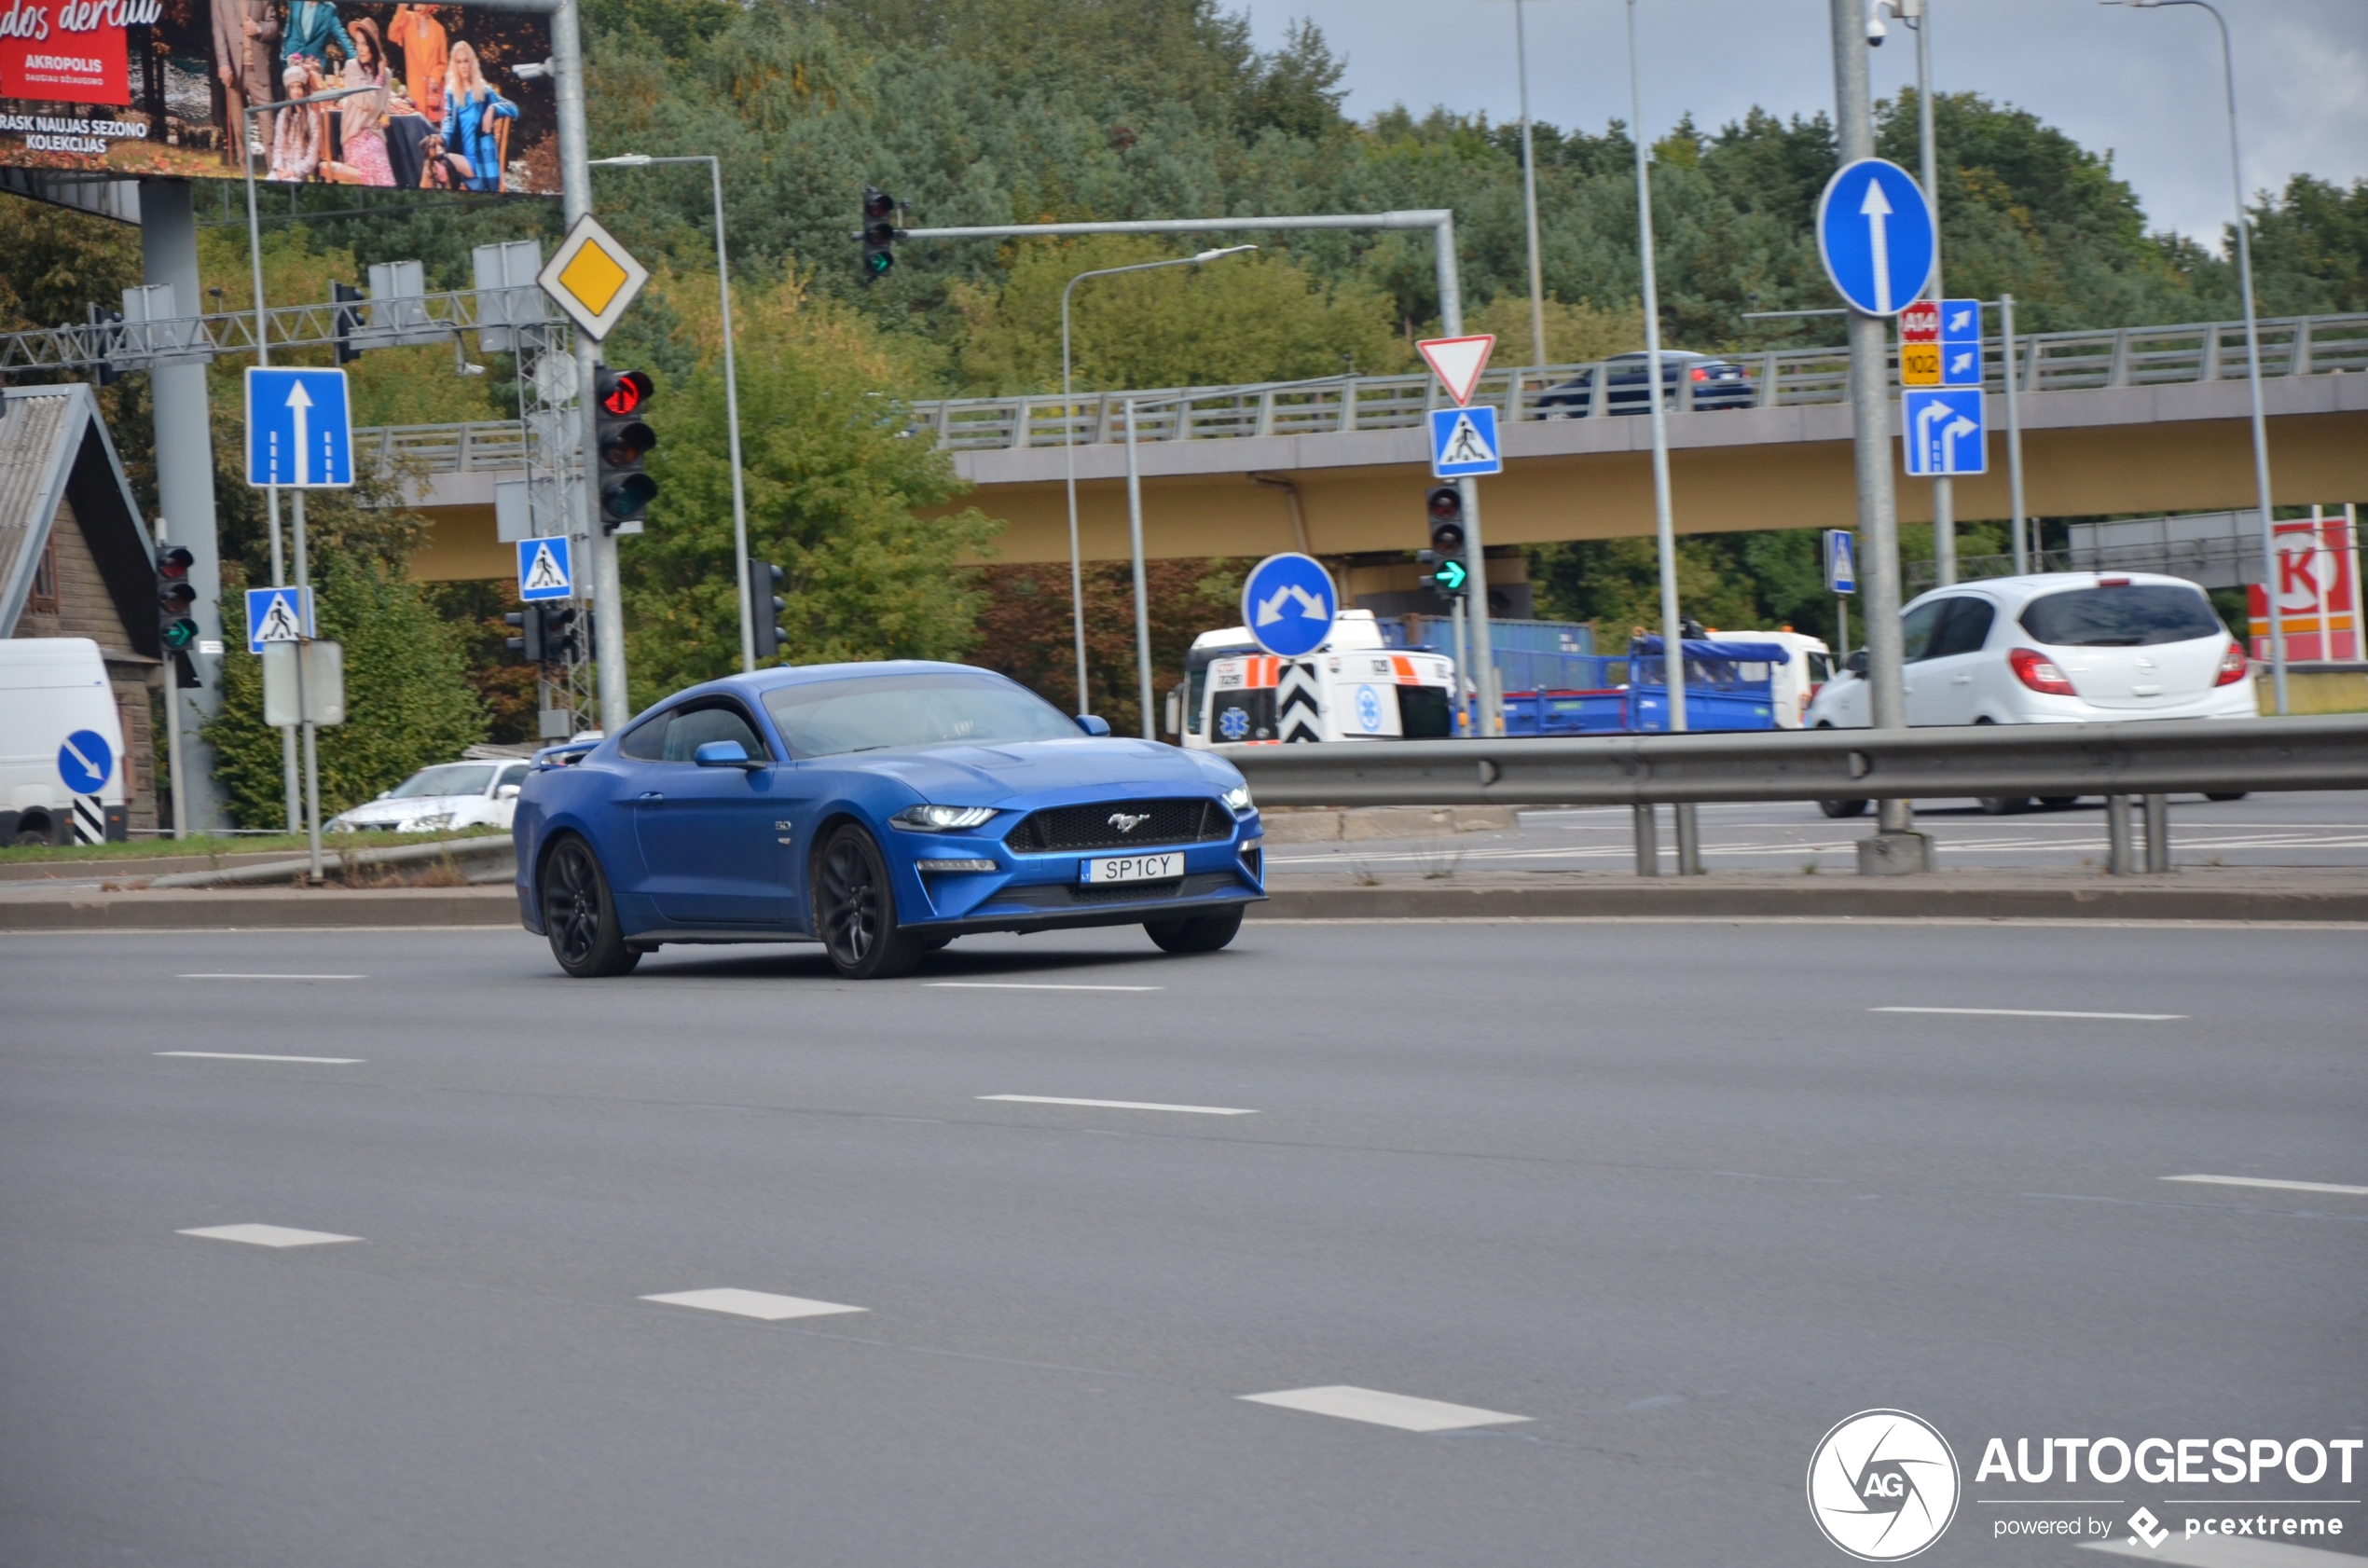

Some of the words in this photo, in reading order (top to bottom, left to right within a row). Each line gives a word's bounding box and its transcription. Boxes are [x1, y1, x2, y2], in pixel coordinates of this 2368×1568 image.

[25, 54, 103, 73] AKROPOLIS
[25, 74, 59, 83] DAUGIAU
[61, 74, 104, 86] DŽIAUGSMO
[35, 117, 90, 134] NAUJAS
[91, 119, 147, 138] SEZONO
[26, 134, 106, 153] KOLEKCIJAS
[1903, 311, 1937, 332] A14
[1907, 355, 1937, 374] 102
[2280, 546, 2319, 597] K
[775, 820, 792, 831] 5.0
[1106, 856, 1170, 879] SP1CY
